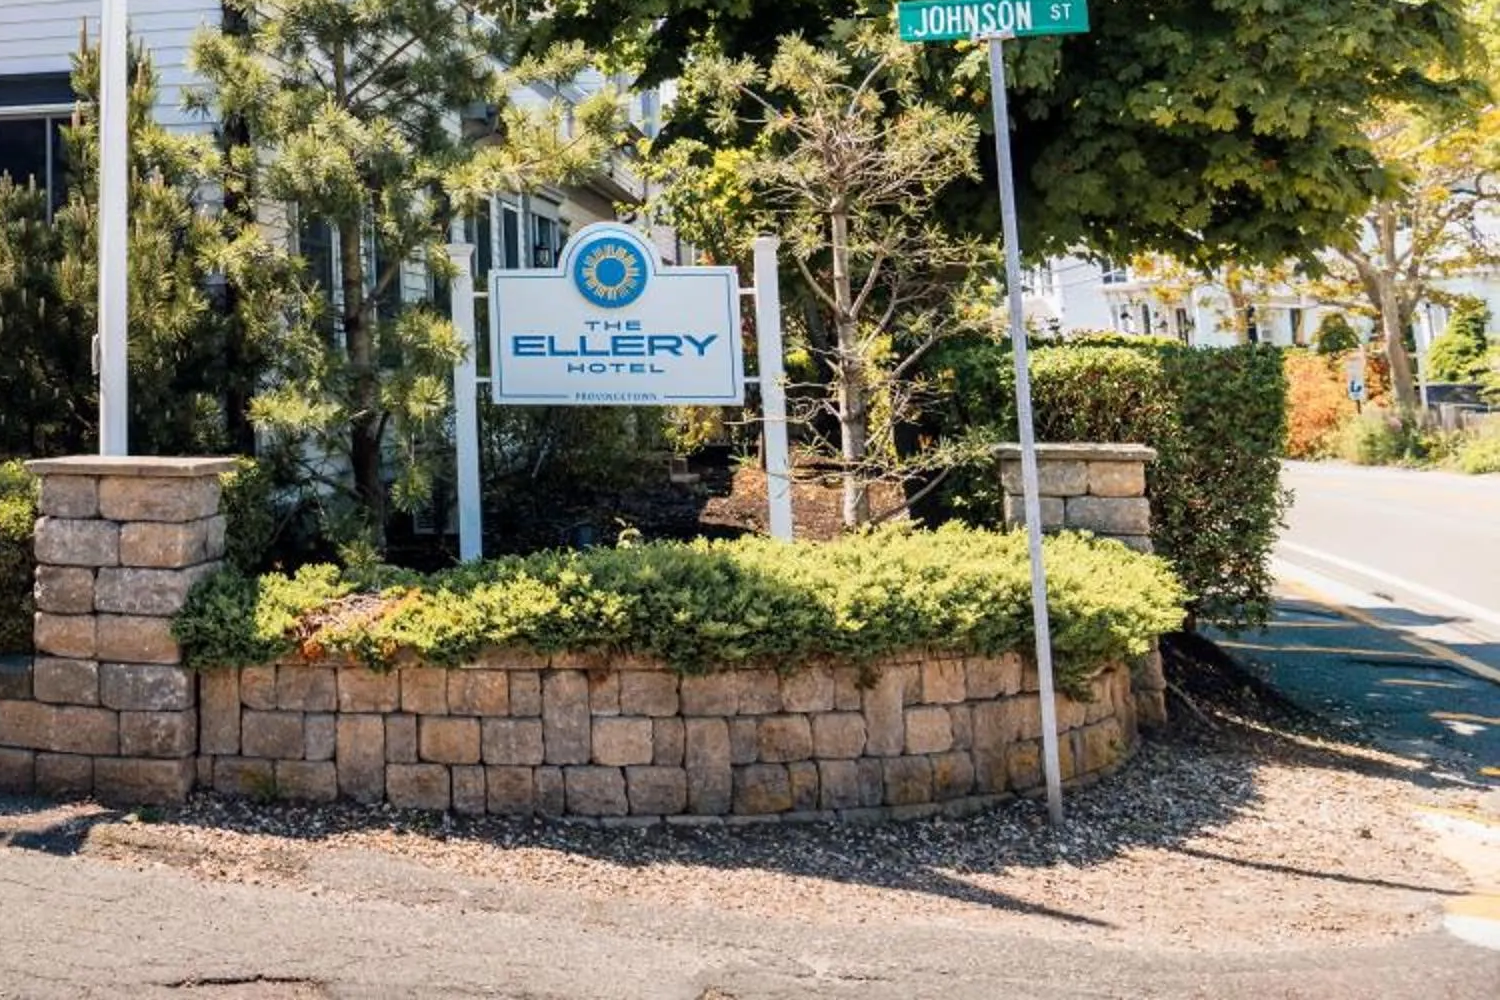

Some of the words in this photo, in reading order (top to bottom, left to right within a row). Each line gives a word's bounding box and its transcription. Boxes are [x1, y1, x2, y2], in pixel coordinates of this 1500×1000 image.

[914, 1, 1032, 37] JOHNSON
[1051, 3, 1072, 20] ST
[585, 320, 642, 331] THE
[512, 335, 717, 356] ELLERY
[568, 363, 665, 373] HOTEL
